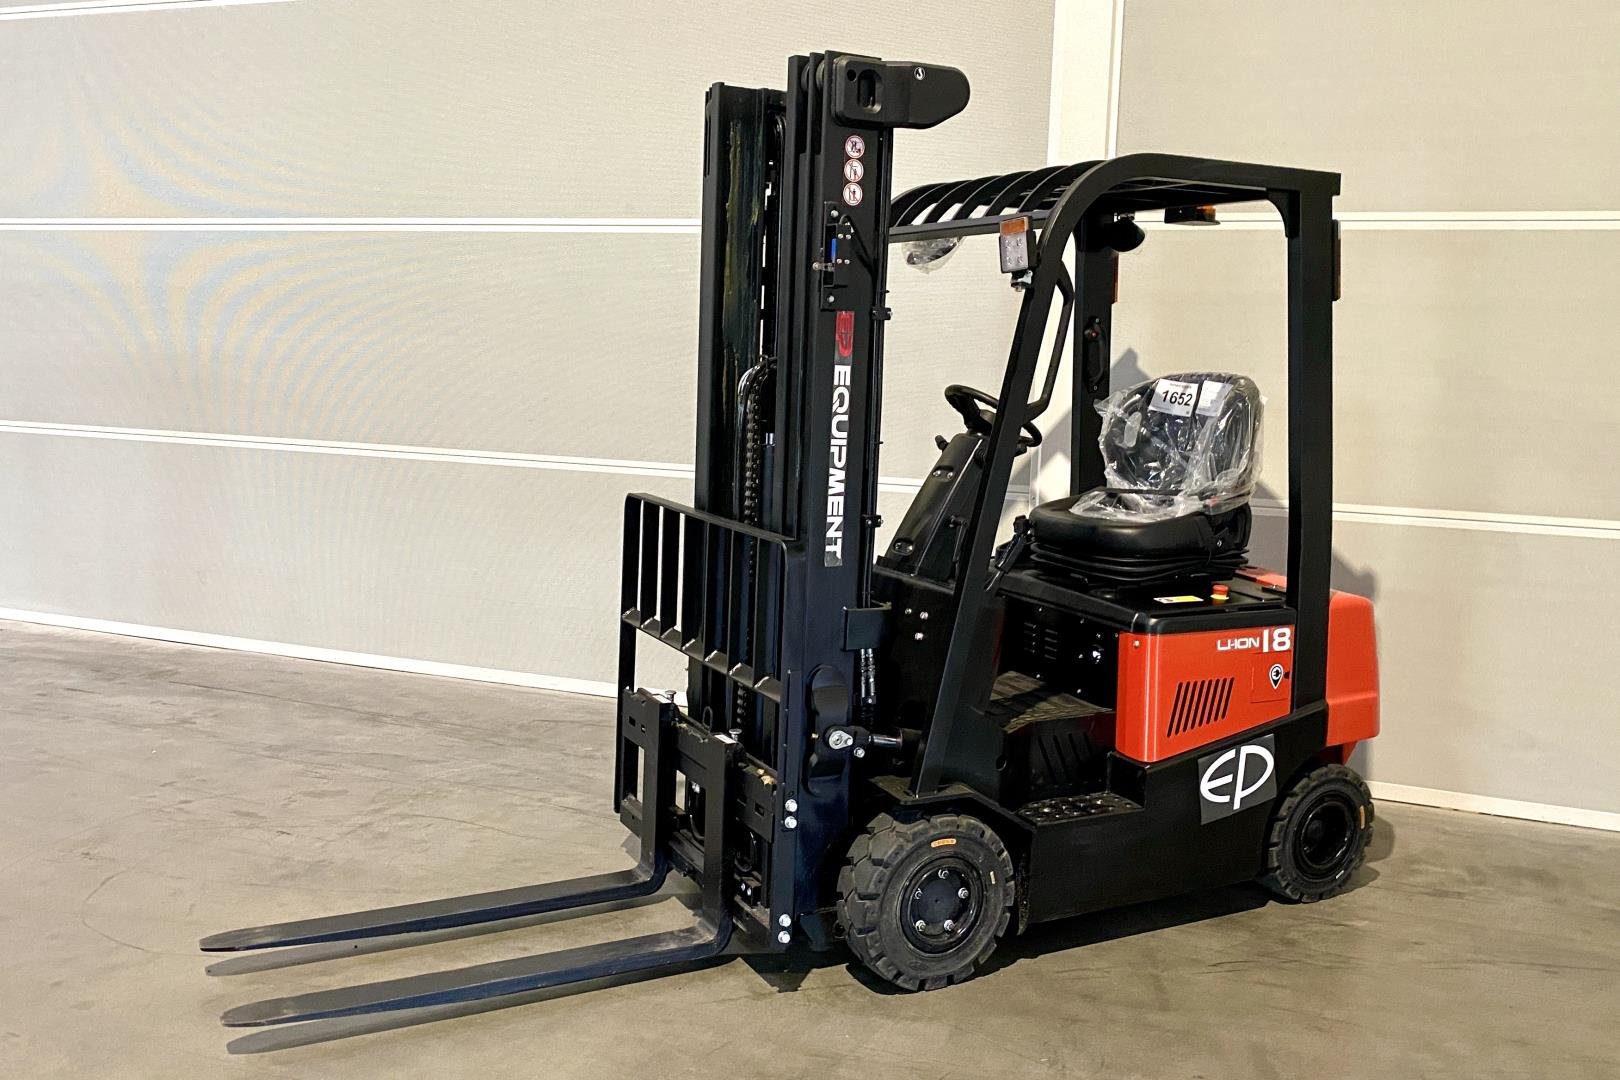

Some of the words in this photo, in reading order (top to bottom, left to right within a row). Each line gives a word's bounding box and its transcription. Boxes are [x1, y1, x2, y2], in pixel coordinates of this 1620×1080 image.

[1162, 390, 1193, 406] 1652
[825, 365, 851, 558] EQUIPMENT
[1262, 627, 1291, 652] 18
[1200, 745, 1275, 810] EP
